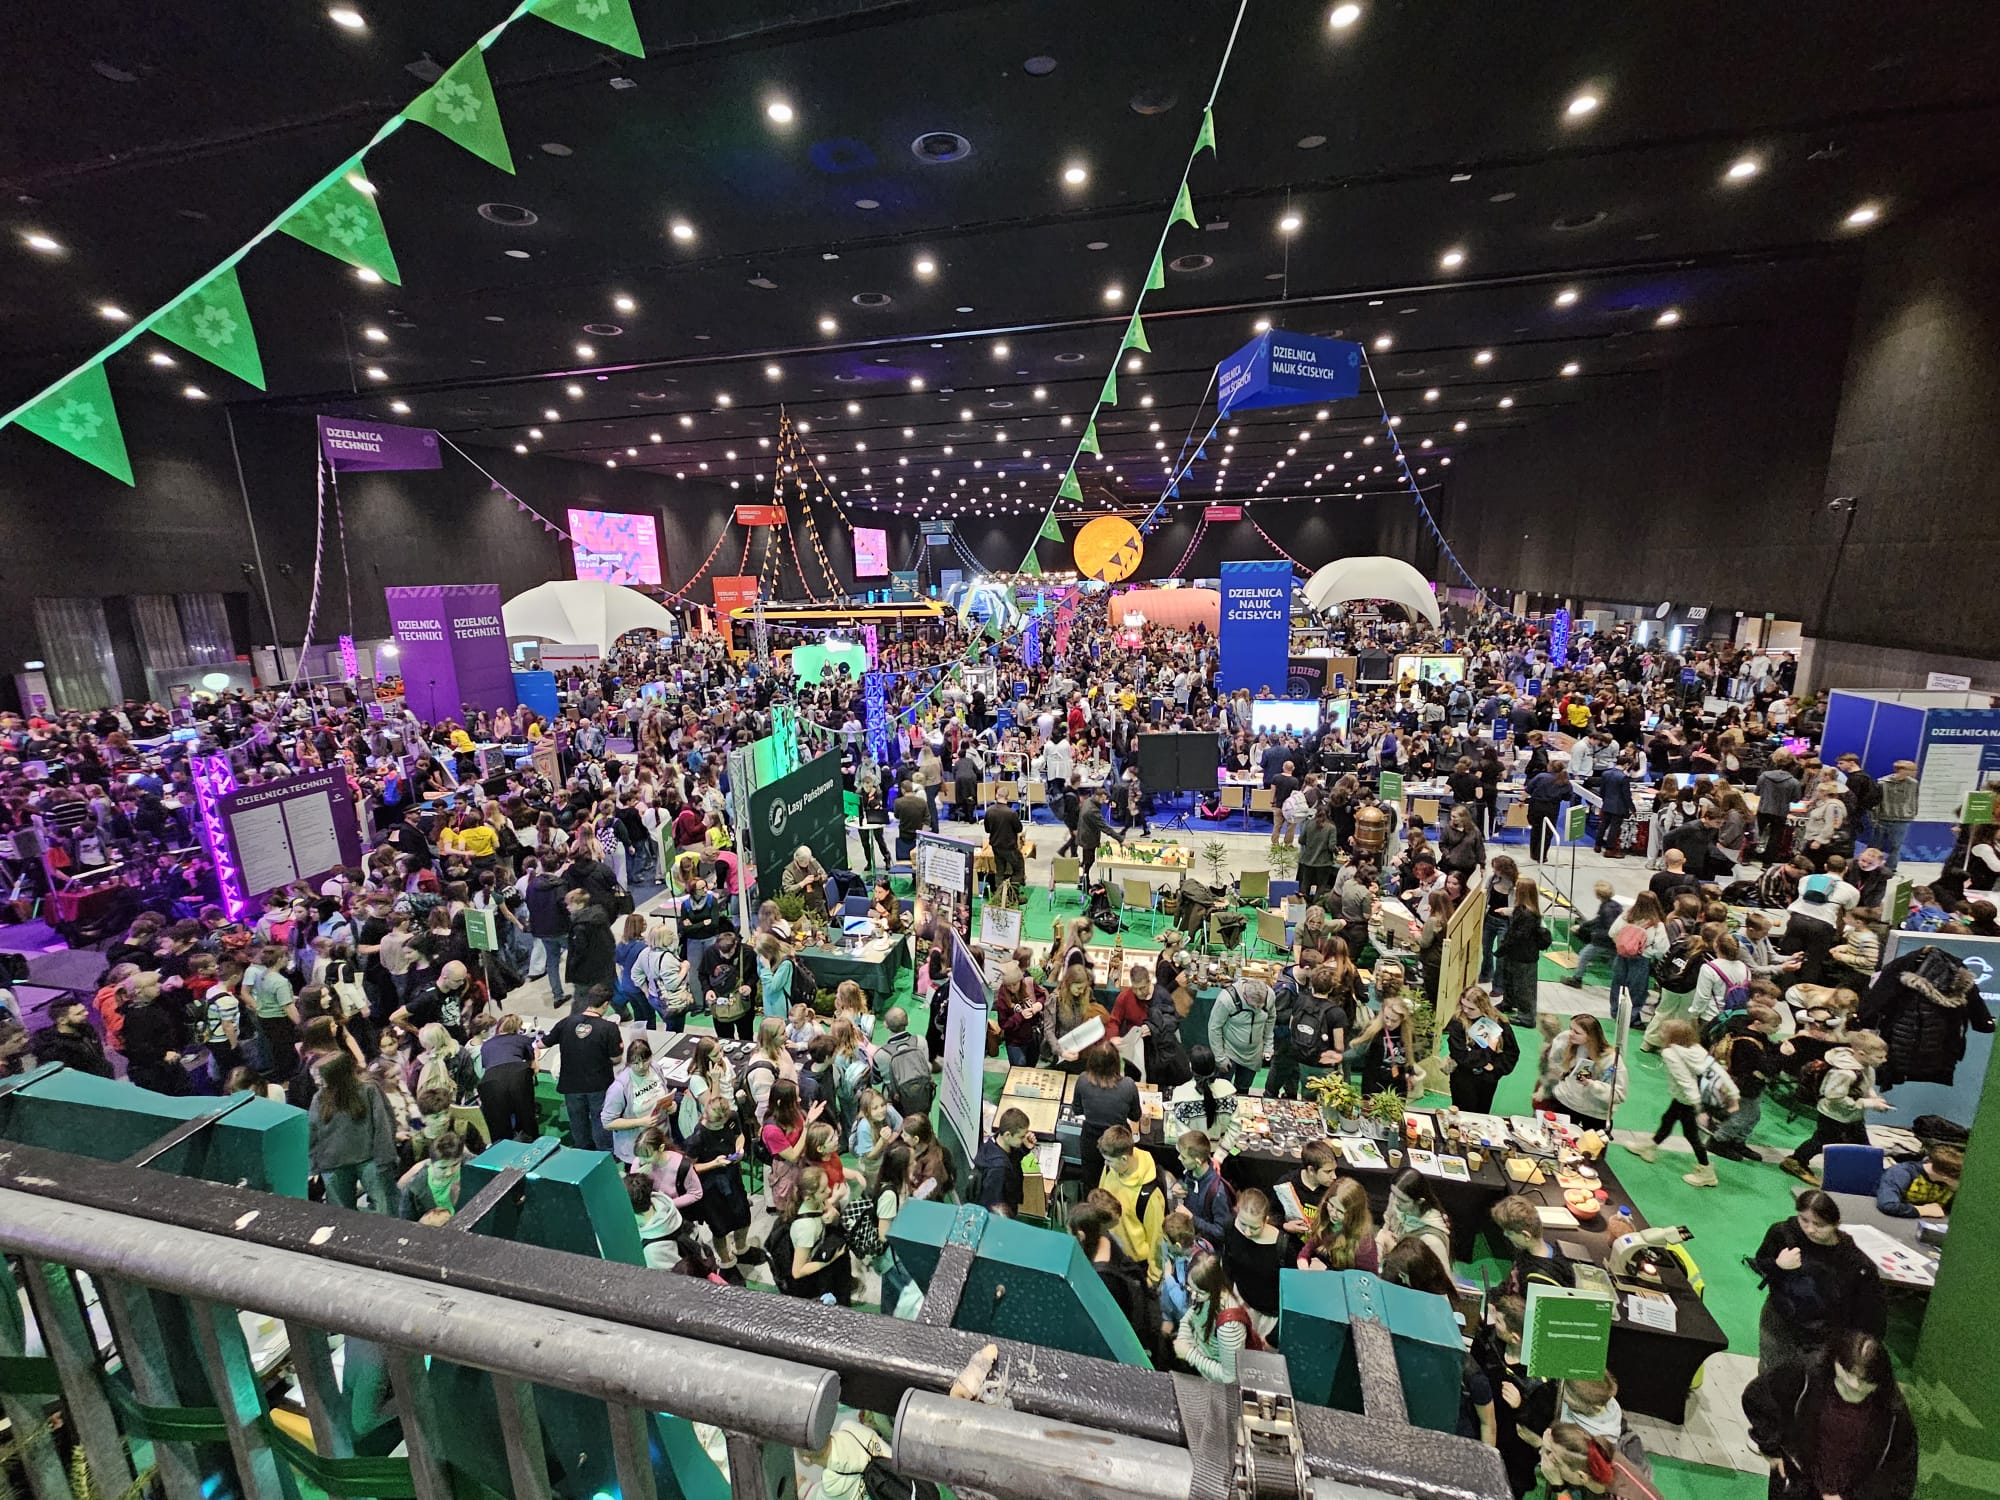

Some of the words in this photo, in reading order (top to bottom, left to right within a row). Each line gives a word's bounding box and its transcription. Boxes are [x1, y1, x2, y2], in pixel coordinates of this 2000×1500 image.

[1273, 345, 1317, 363] DZIELNICA
[1272, 362, 1296, 375] NAUK
[1297, 364, 1334, 380] ŚCISŁYCH
[326, 427, 383, 442] DZIELNICA
[328, 439, 381, 453] TECHNIKI
[1228, 588, 1283, 598] DZIELNICA
[1239, 599, 1271, 609] NAUK
[1228, 609, 1282, 620] ŚCISŁYCH
[397, 619, 442, 630] DZIELNICA
[453, 615, 499, 629] DZIELNICA
[398, 631, 443, 641] TECHNIKI
[454, 626, 501, 640] TECHNIKI
[1288, 666, 1321, 678] UDIES
[1931, 728, 1988, 737] DZIELNICA
[236, 787, 289, 806] DZIELNICA
[288, 776, 334, 793] TECHNIKI
[787, 798, 803, 816] Lasy
[803, 778, 834, 806] Państwowe
